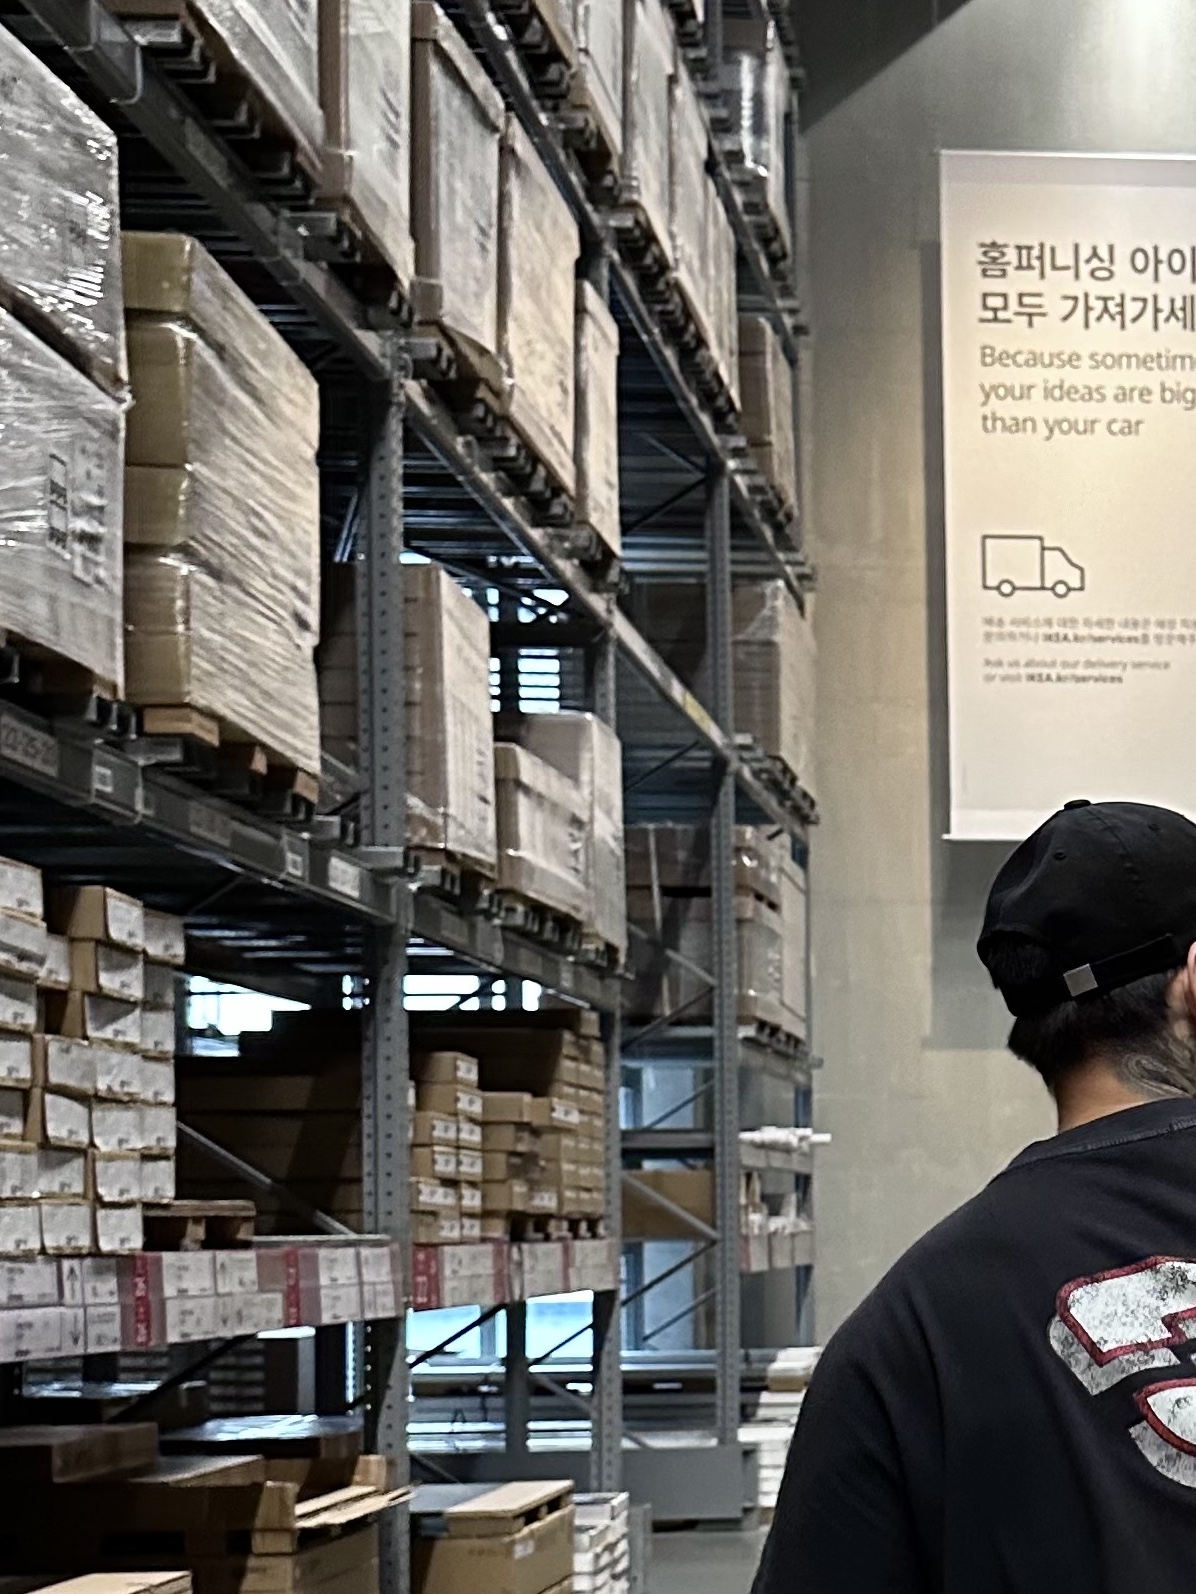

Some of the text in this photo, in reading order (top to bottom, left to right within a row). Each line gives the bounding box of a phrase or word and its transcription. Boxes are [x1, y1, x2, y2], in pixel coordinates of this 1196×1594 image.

[976, 240, 1116, 282] 홈퍼니싱
[977, 292, 1050, 330] 모두
[979, 345, 1082, 371] Because
[979, 382, 1036, 407] your
[1042, 378, 1107, 404] ideas
[1113, 385, 1153, 405] are
[981, 409, 1146, 441] than your car
